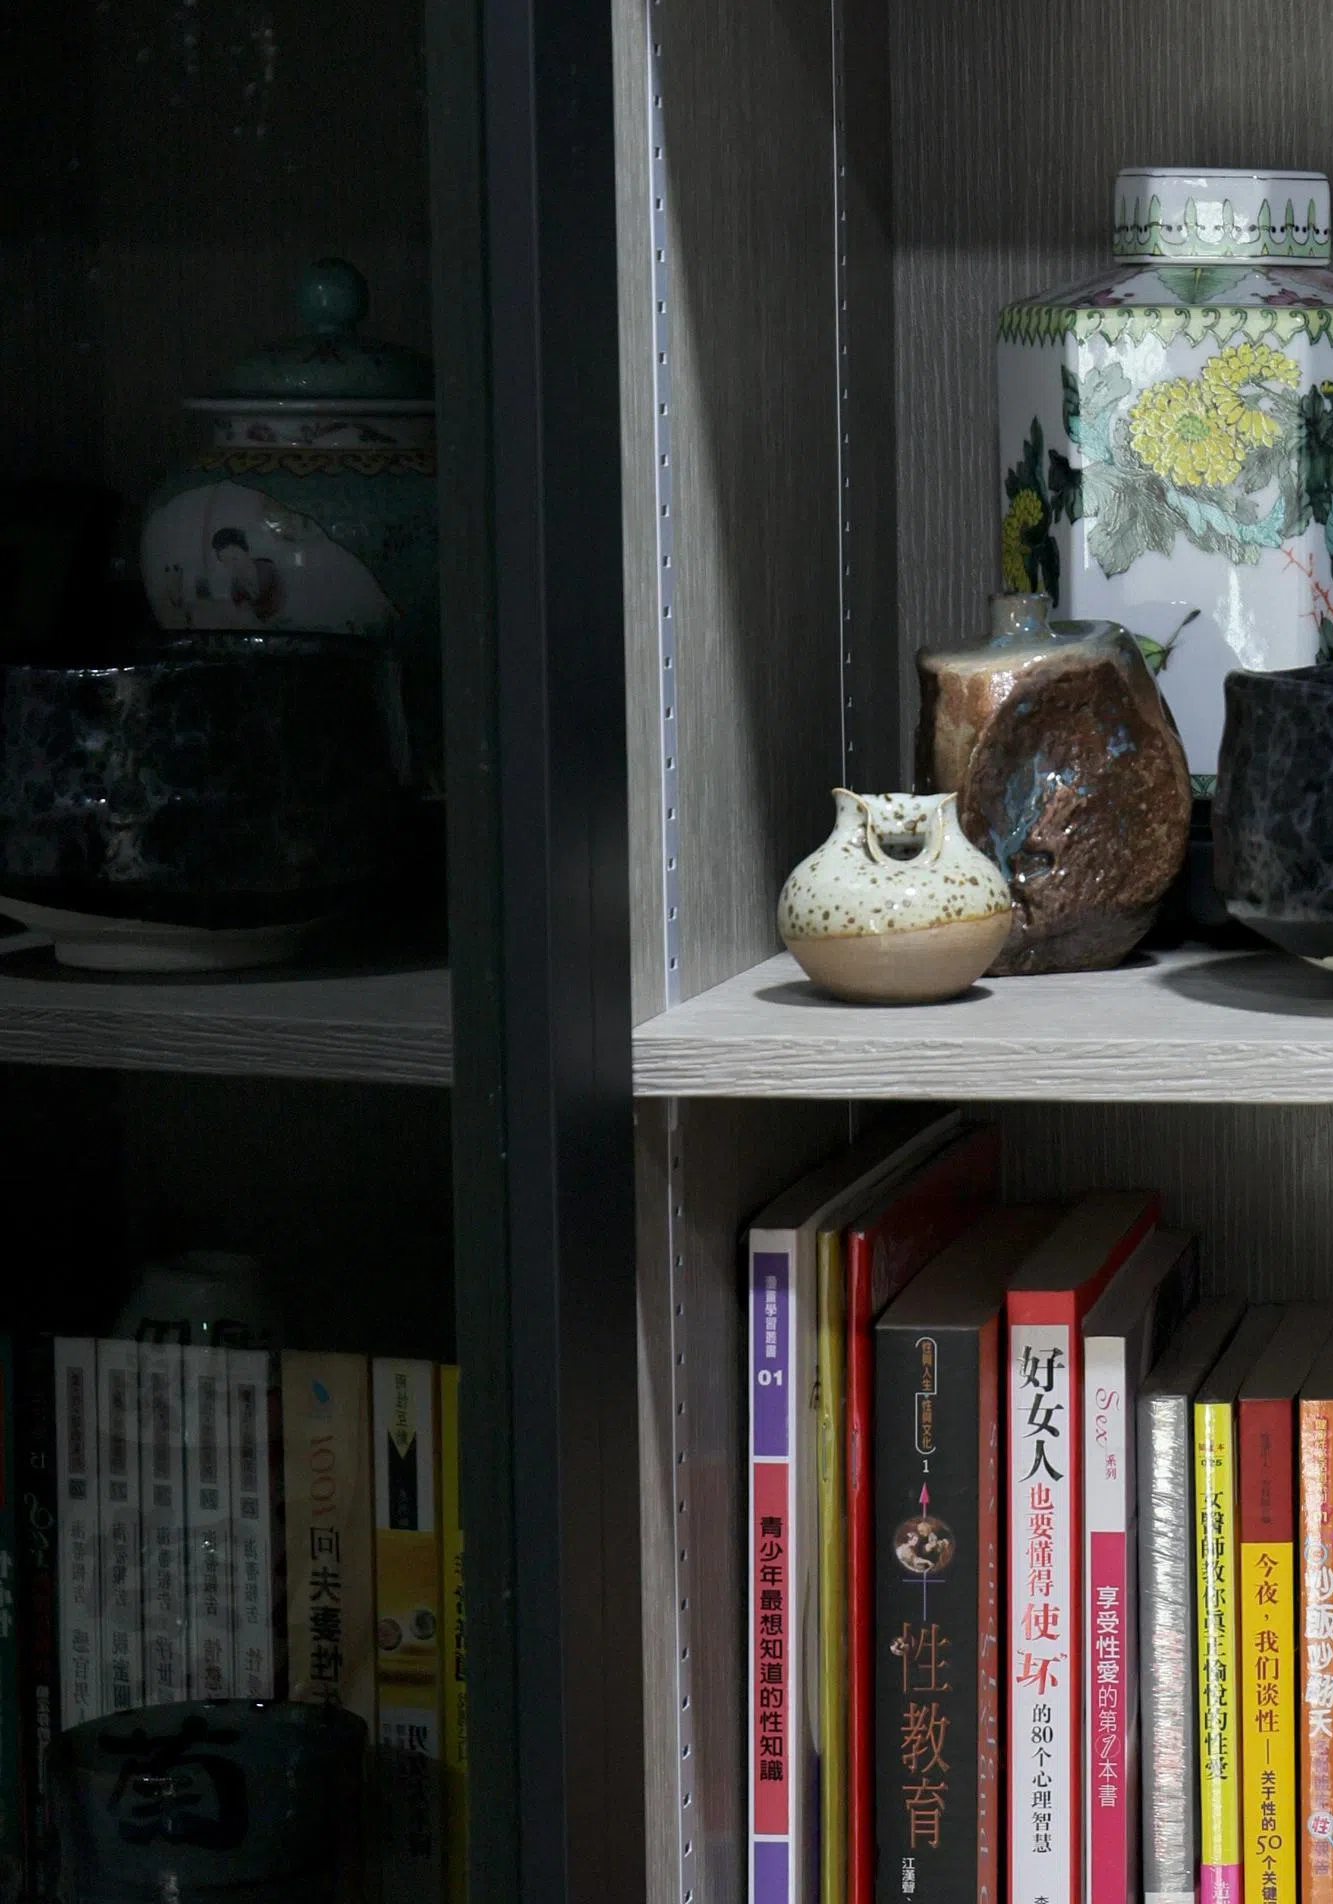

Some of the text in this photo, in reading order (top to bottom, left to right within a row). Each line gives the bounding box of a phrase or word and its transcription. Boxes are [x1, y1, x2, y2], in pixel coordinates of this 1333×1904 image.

[758, 1369, 784, 1387] 01
[759, 1515, 783, 1782] 青少年最想知道的性知識
[900, 1622, 953, 1851] 性教育
